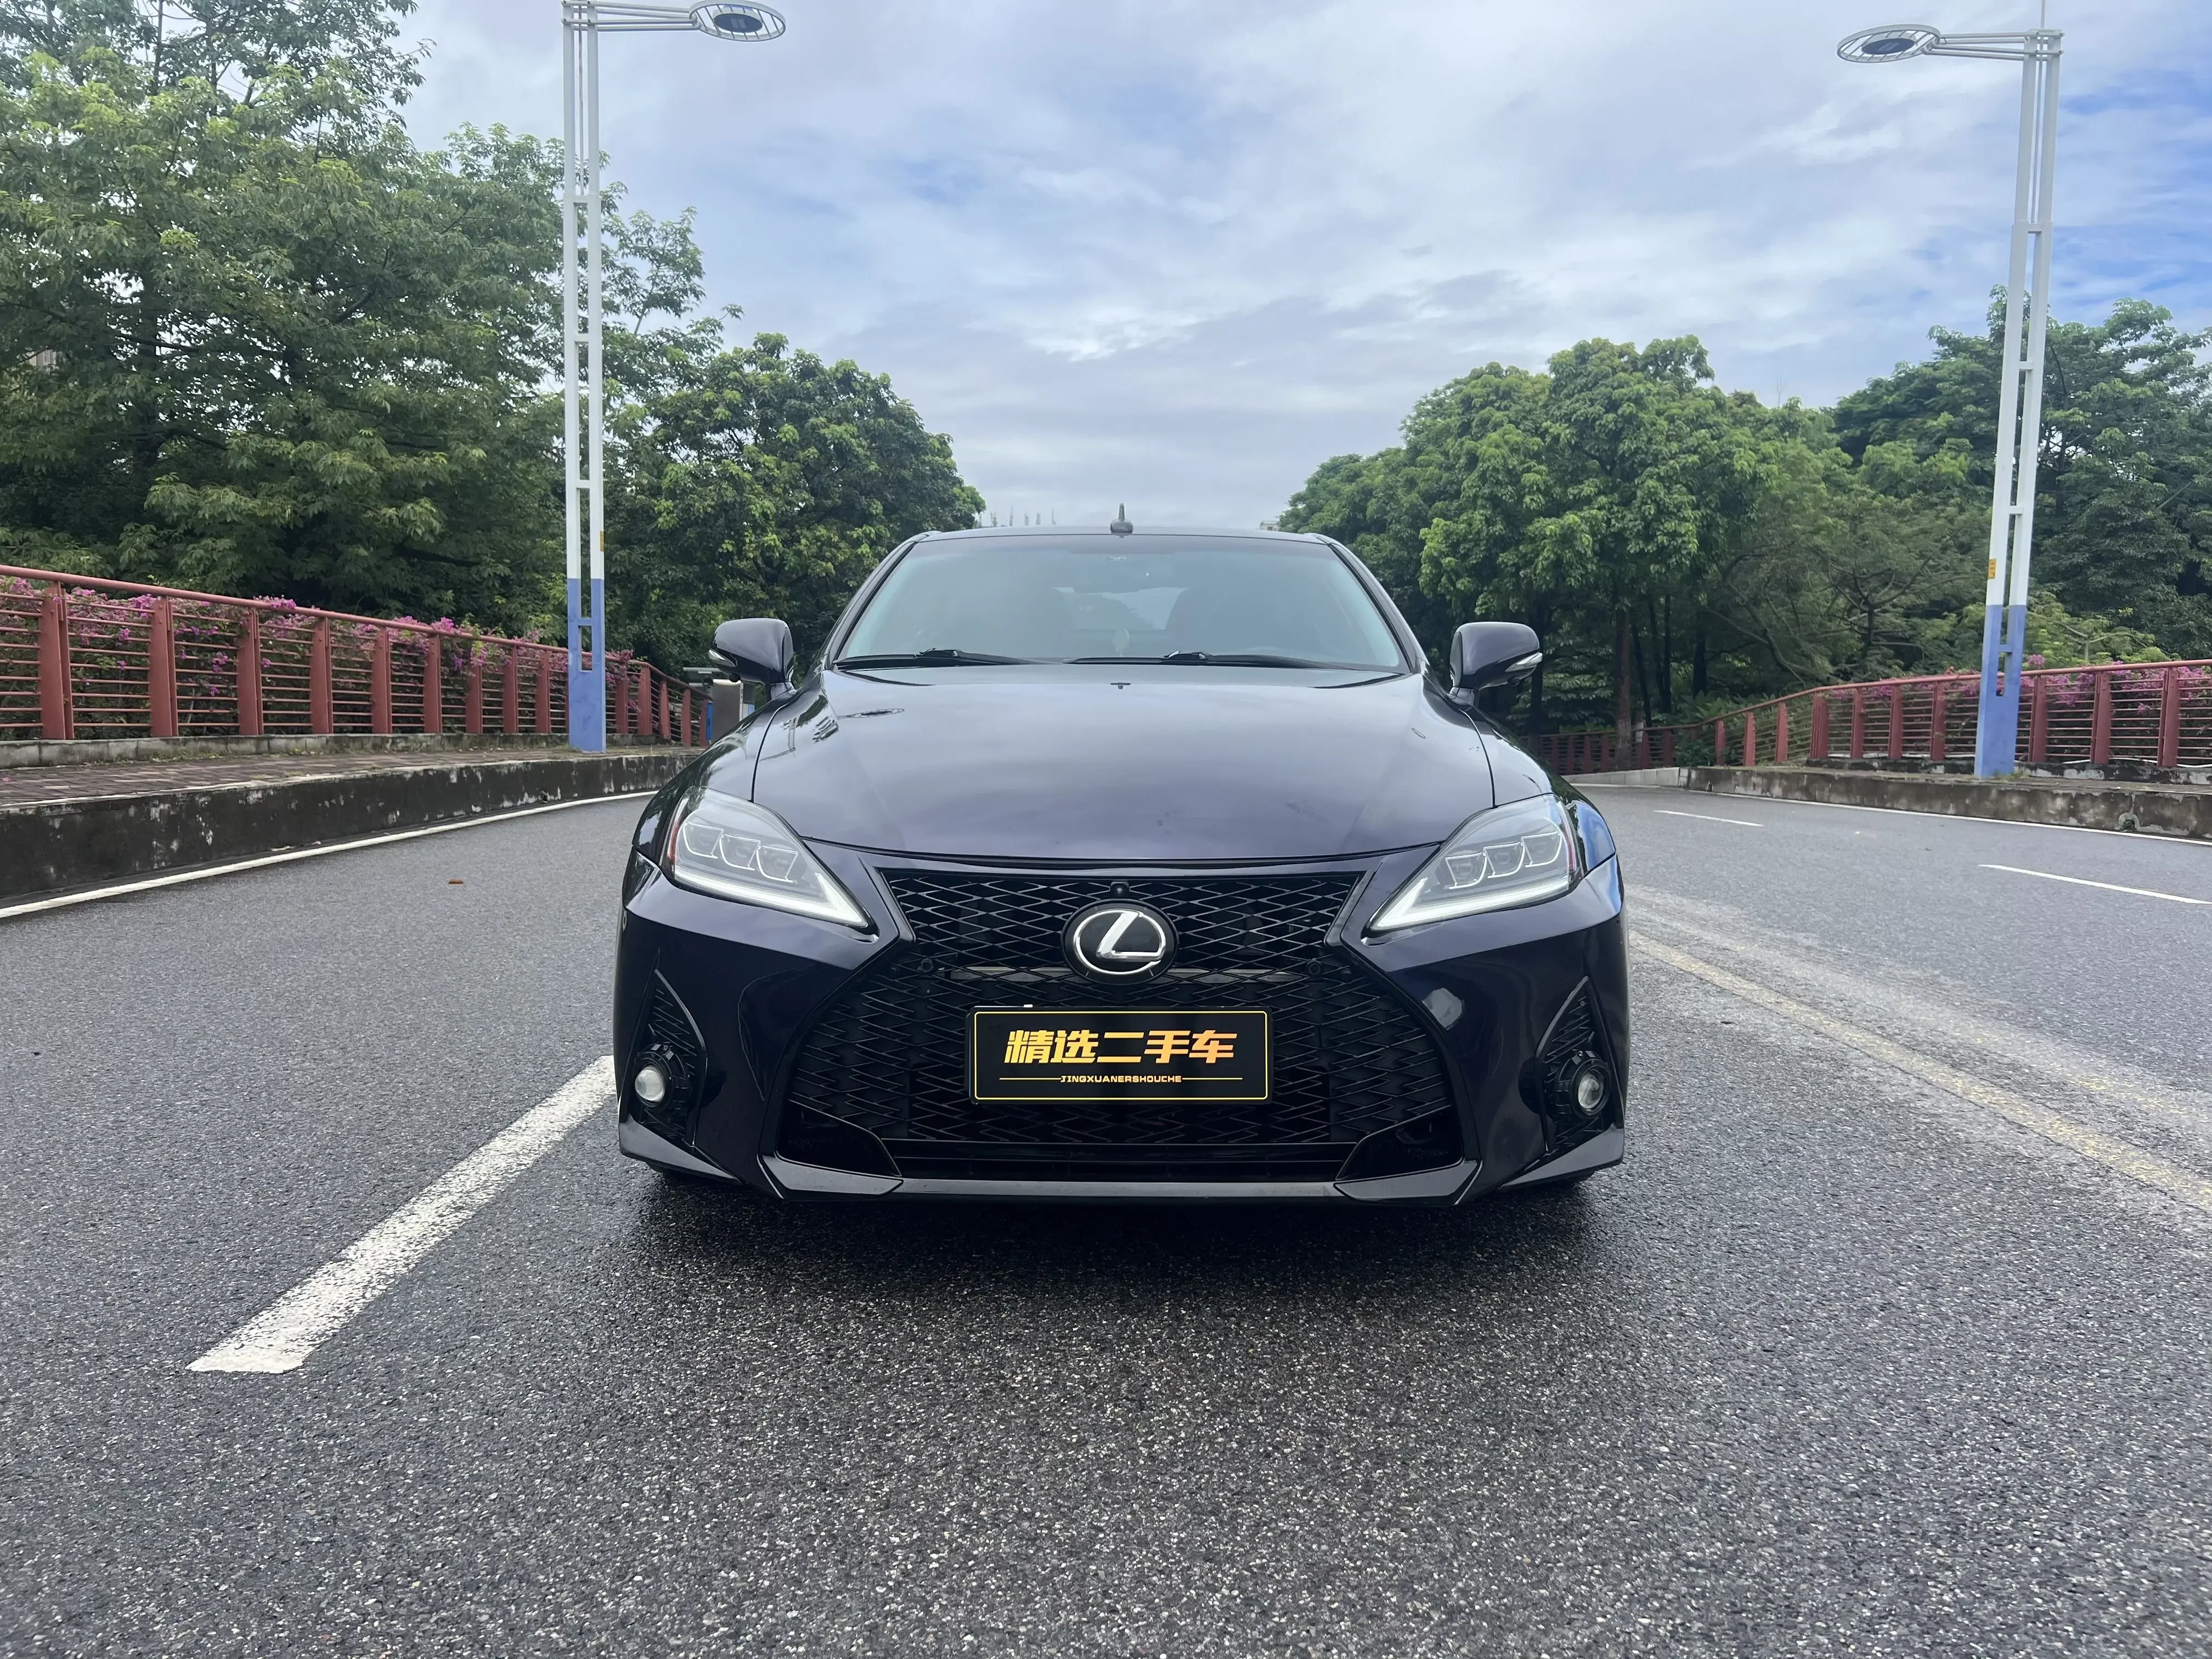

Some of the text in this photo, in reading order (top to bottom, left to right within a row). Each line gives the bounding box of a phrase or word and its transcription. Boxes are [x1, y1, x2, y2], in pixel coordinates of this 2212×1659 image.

[1004, 1029, 1238, 1064] 精选二手车
